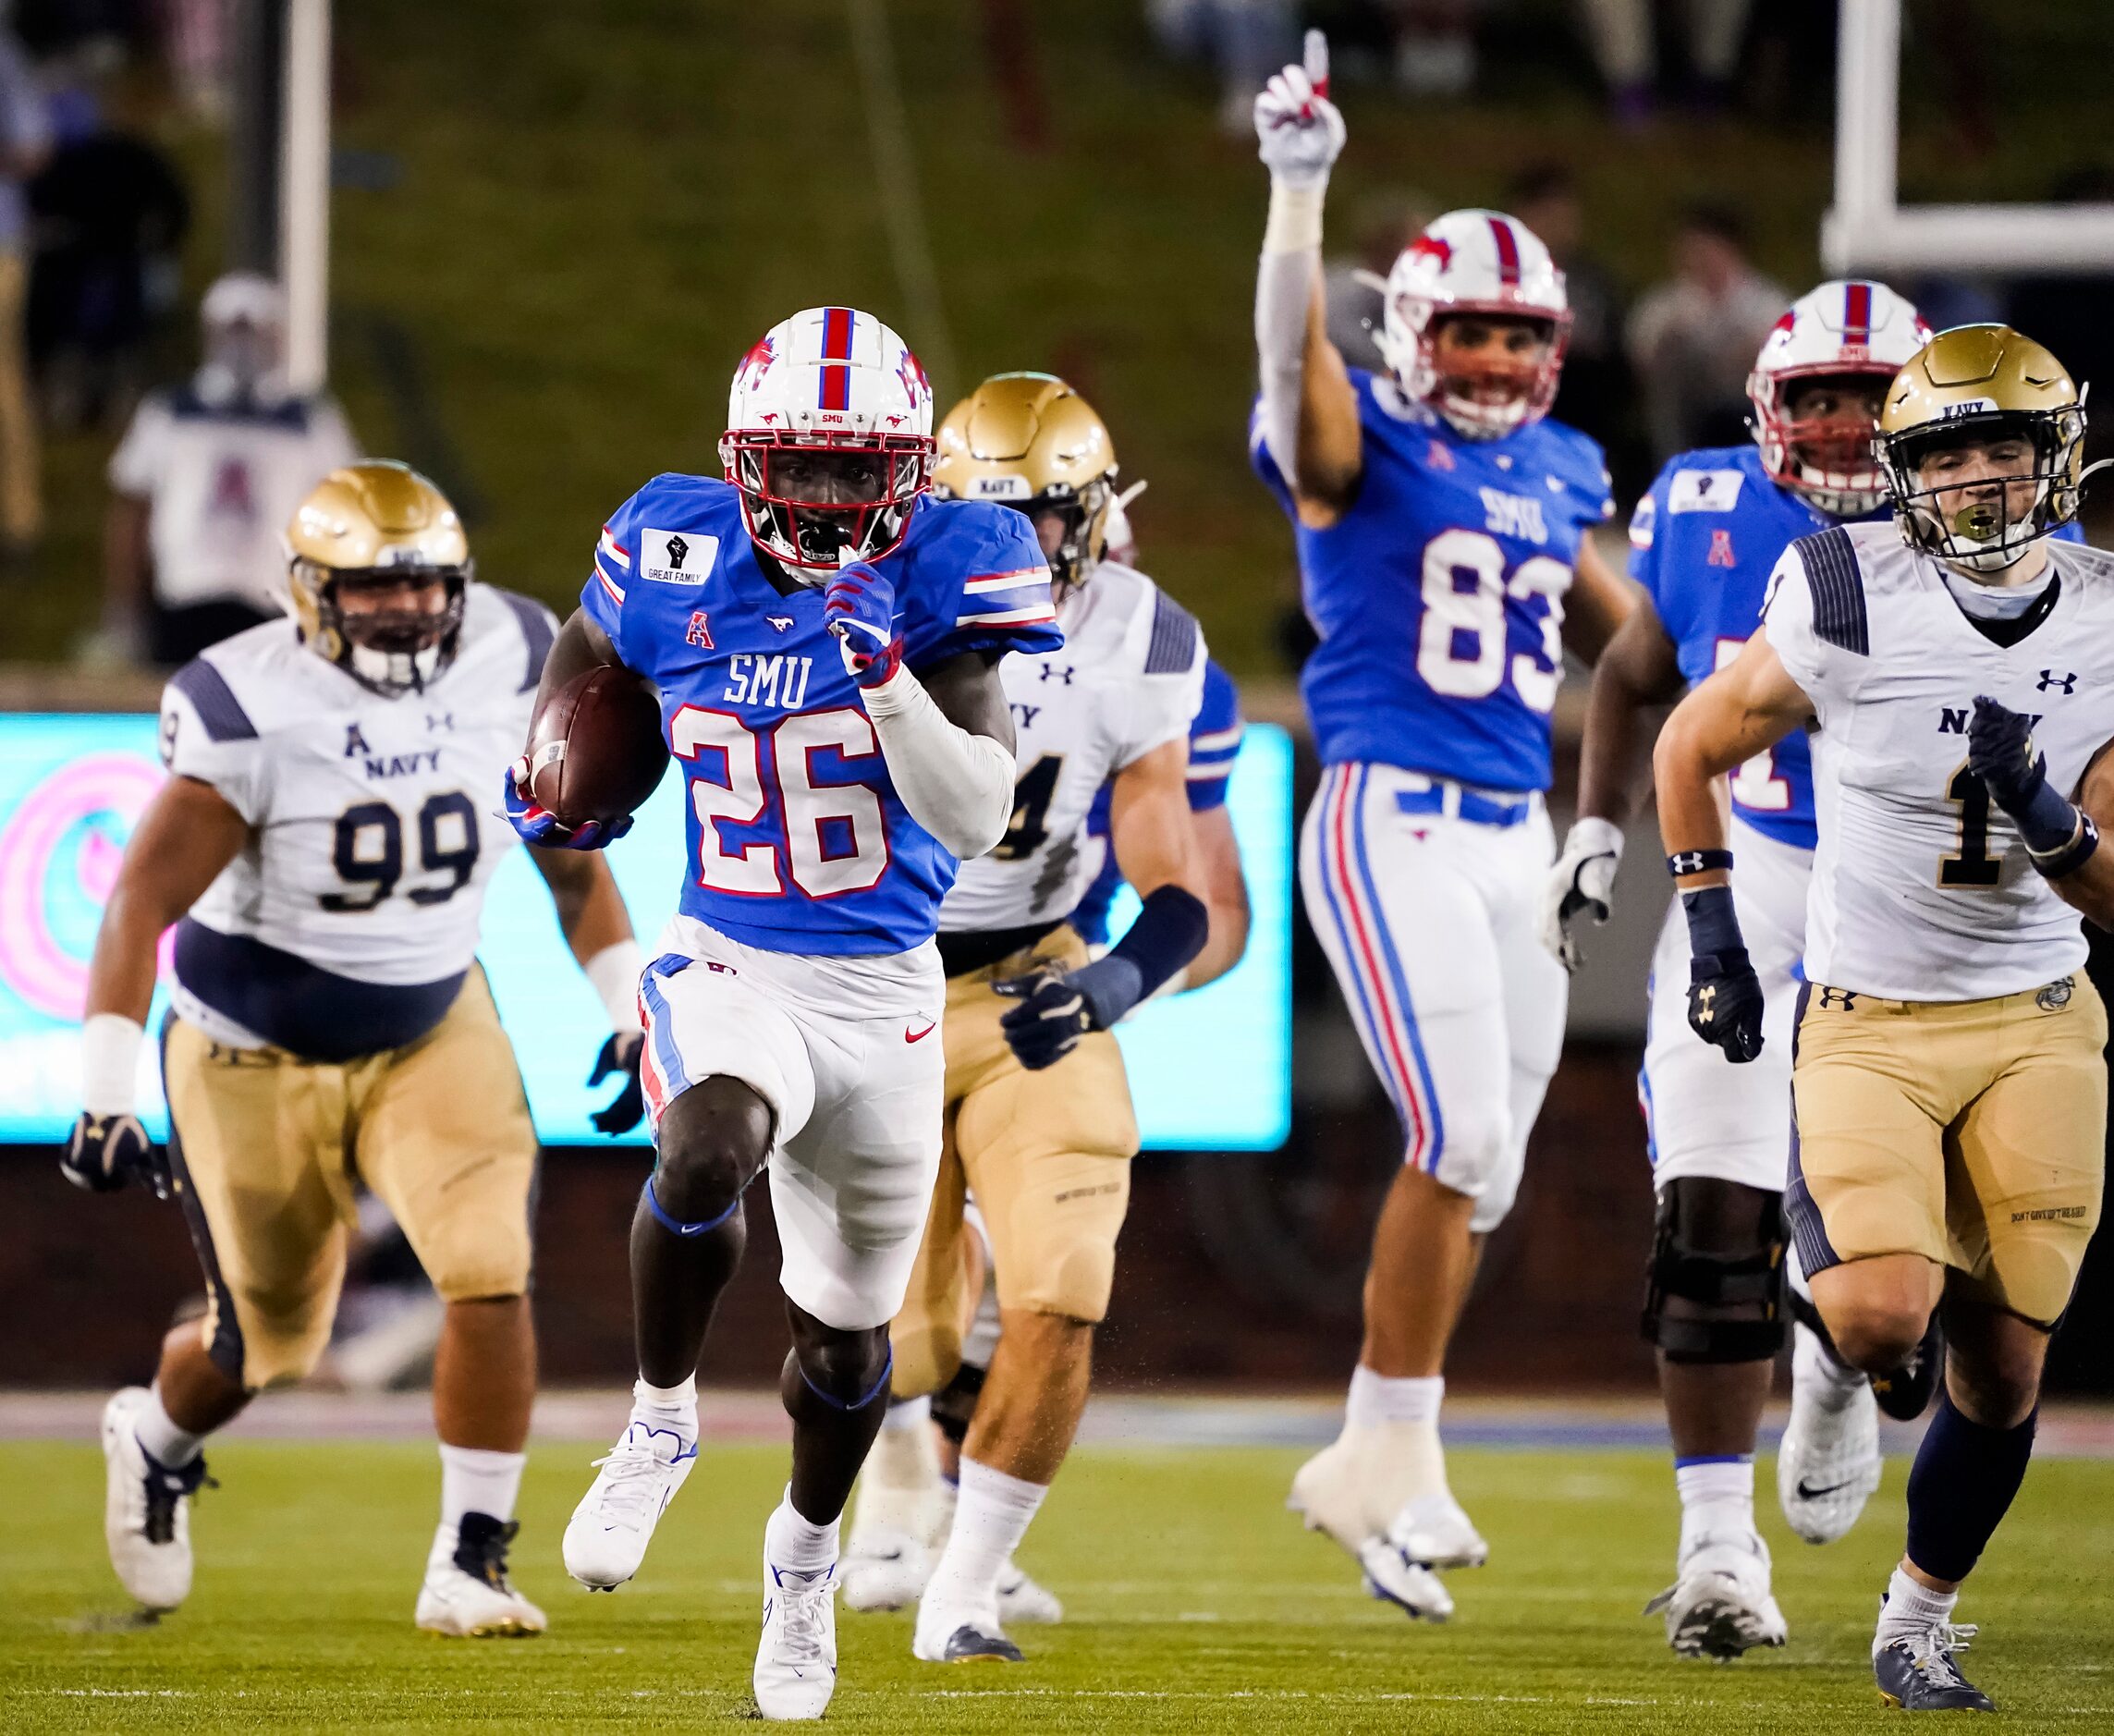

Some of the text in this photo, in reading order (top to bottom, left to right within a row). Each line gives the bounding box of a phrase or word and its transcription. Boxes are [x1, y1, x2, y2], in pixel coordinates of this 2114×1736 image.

[822, 414, 843, 423] SMU
[1943, 401, 1984, 418] NAVY
[980, 479, 1014, 494] NAVY
[1480, 486, 1548, 545] SMU
[648, 568, 703, 583] GREAT FAMILY
[686, 611, 715, 650] A
[1415, 528, 1573, 715] 83
[723, 654, 813, 710] SMU
[366, 749, 441, 779] NAVY
[669, 703, 902, 902] 26
[1936, 755, 2004, 888] 1
[318, 790, 481, 913] 99
